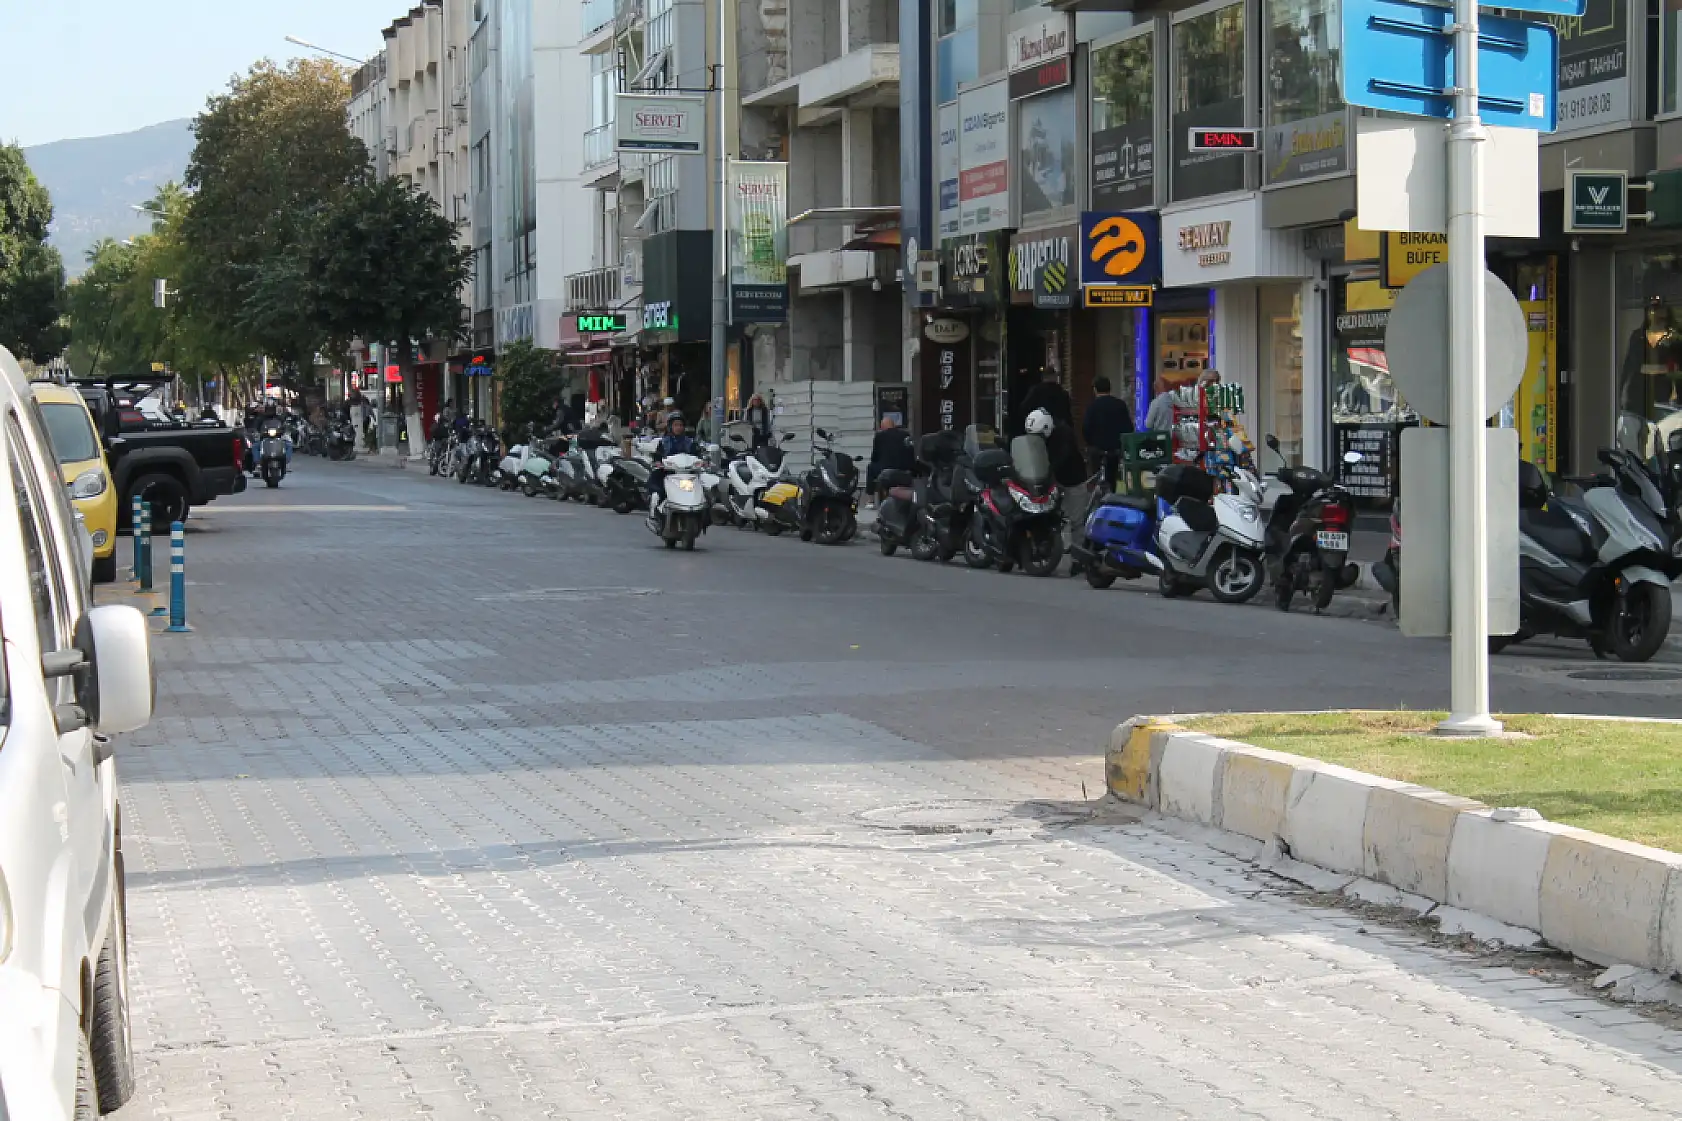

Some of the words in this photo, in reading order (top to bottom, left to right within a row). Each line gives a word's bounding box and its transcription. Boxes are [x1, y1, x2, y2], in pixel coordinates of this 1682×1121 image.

[635, 113, 684, 128] SERVET
[1204, 132, 1243, 145] EMIN
[738, 182, 779, 196] SERVET
[1178, 220, 1231, 252] SEAWAY
[1400, 231, 1447, 245] BIRKAN
[1407, 248, 1440, 264] BÜFE
